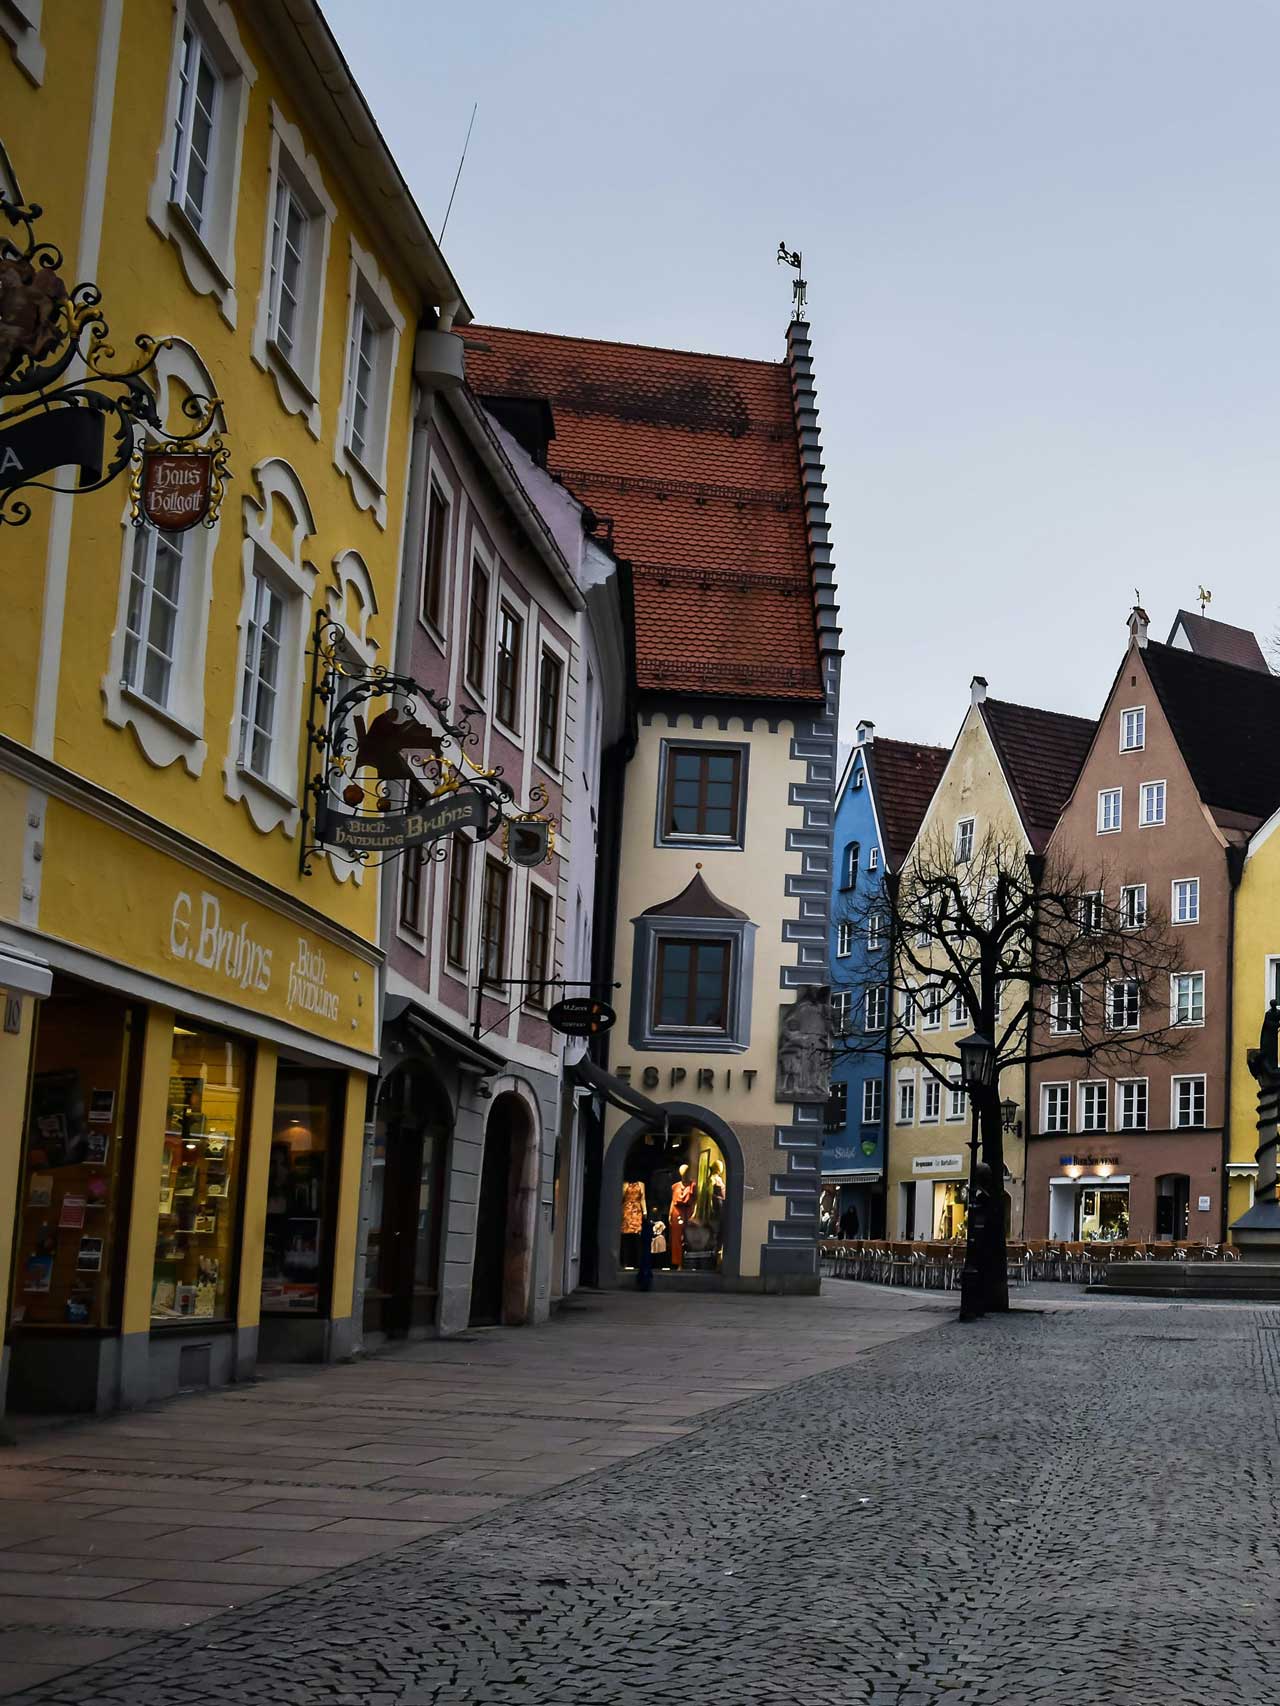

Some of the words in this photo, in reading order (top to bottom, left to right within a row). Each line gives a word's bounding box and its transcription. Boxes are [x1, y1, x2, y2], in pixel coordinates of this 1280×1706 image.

[154, 462, 201, 488] Haus
[350, 820, 391, 833] Buch-
[405, 804, 473, 839] Bruhns
[616, 1065, 758, 1093] ESPRIT
